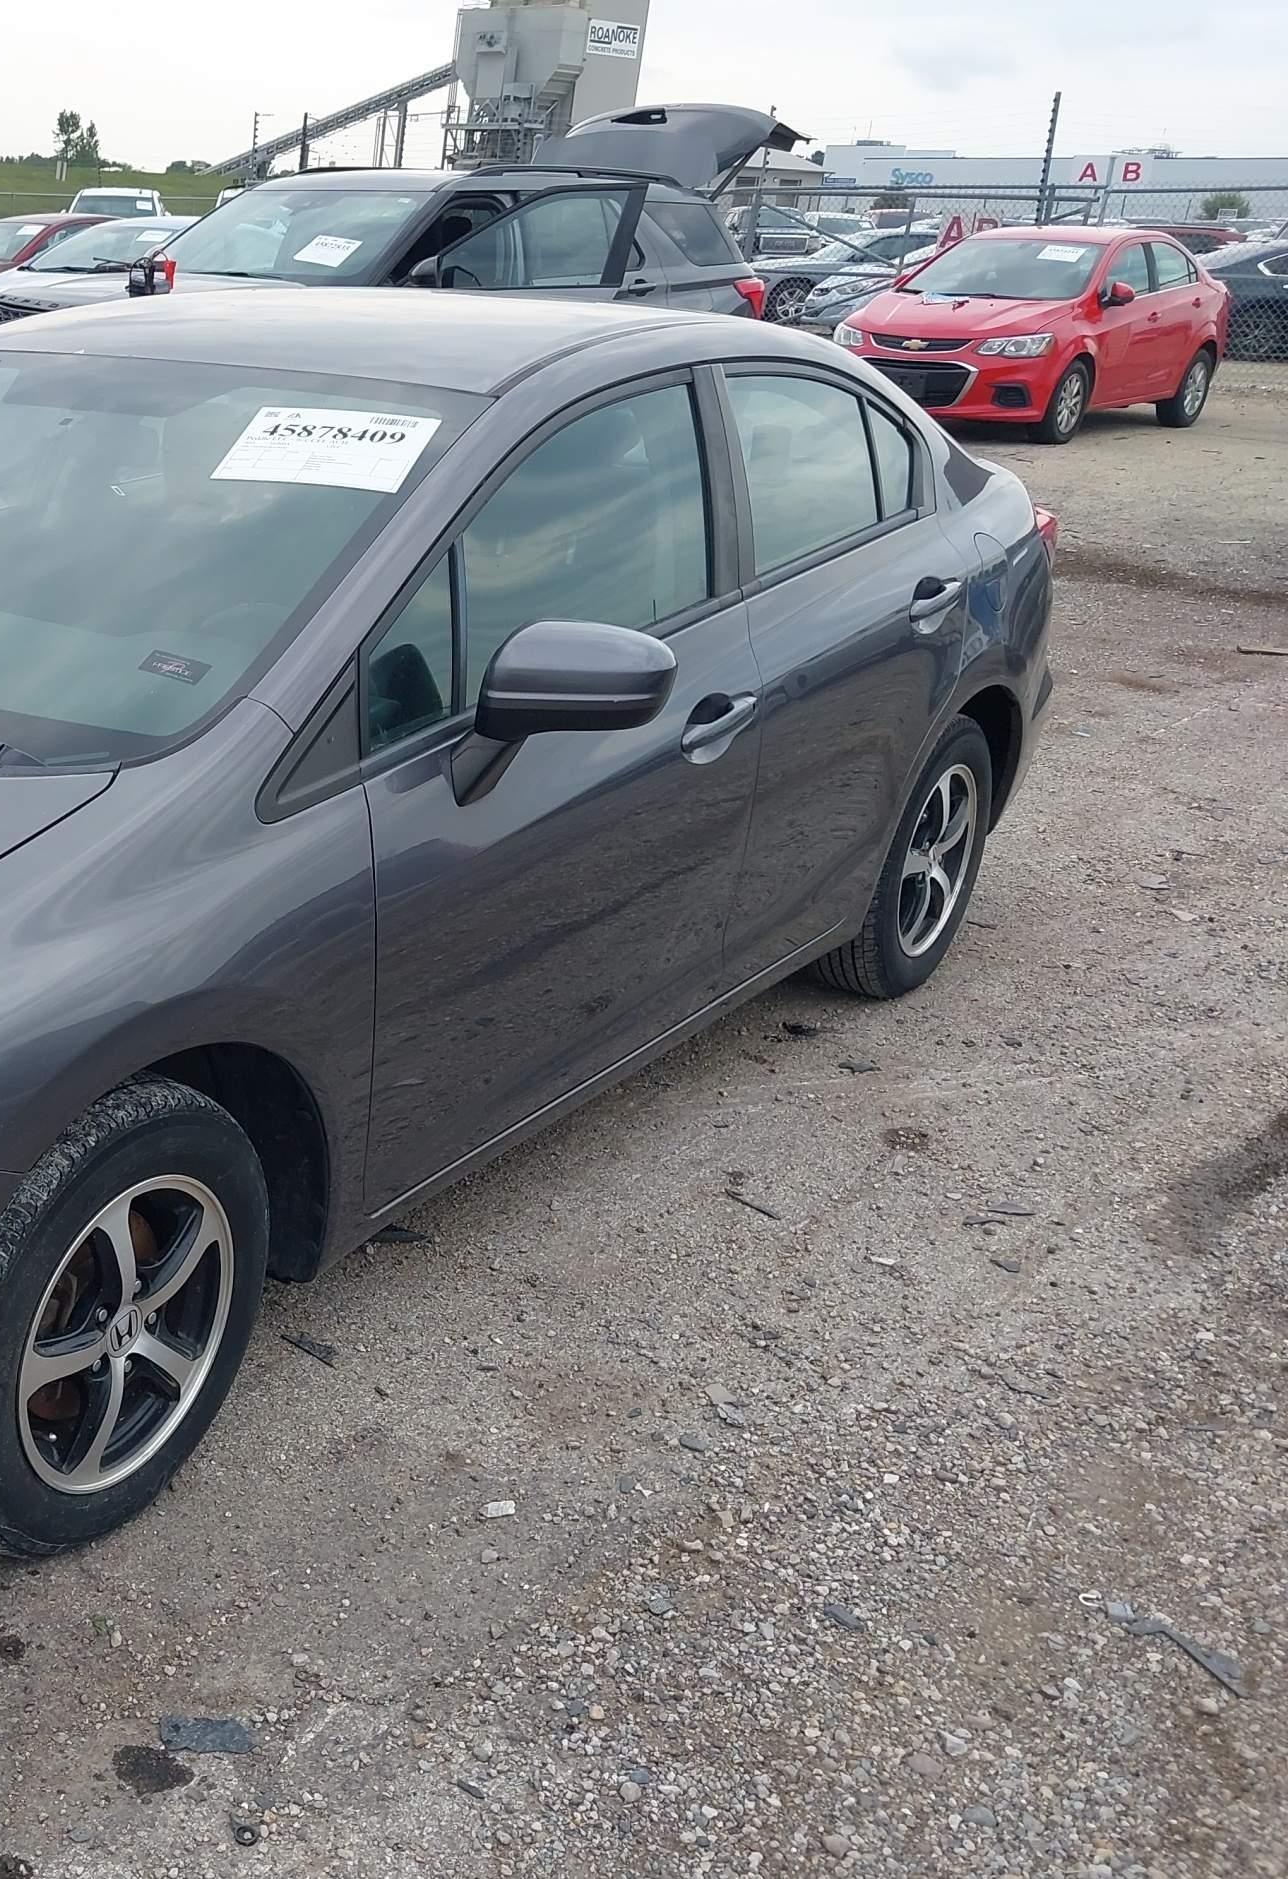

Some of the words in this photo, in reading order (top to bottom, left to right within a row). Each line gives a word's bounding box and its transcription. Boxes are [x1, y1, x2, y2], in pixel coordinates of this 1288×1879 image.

[589, 25, 638, 45] ROANOKE
[588, 44, 611, 54] CONCRETE
[612, 47, 635, 57] PRODUCTS
[890, 167, 934, 185] Sysco
[1078, 162, 1097, 182] A
[1122, 162, 1141, 182] B
[262, 423, 406, 445] 45878409
